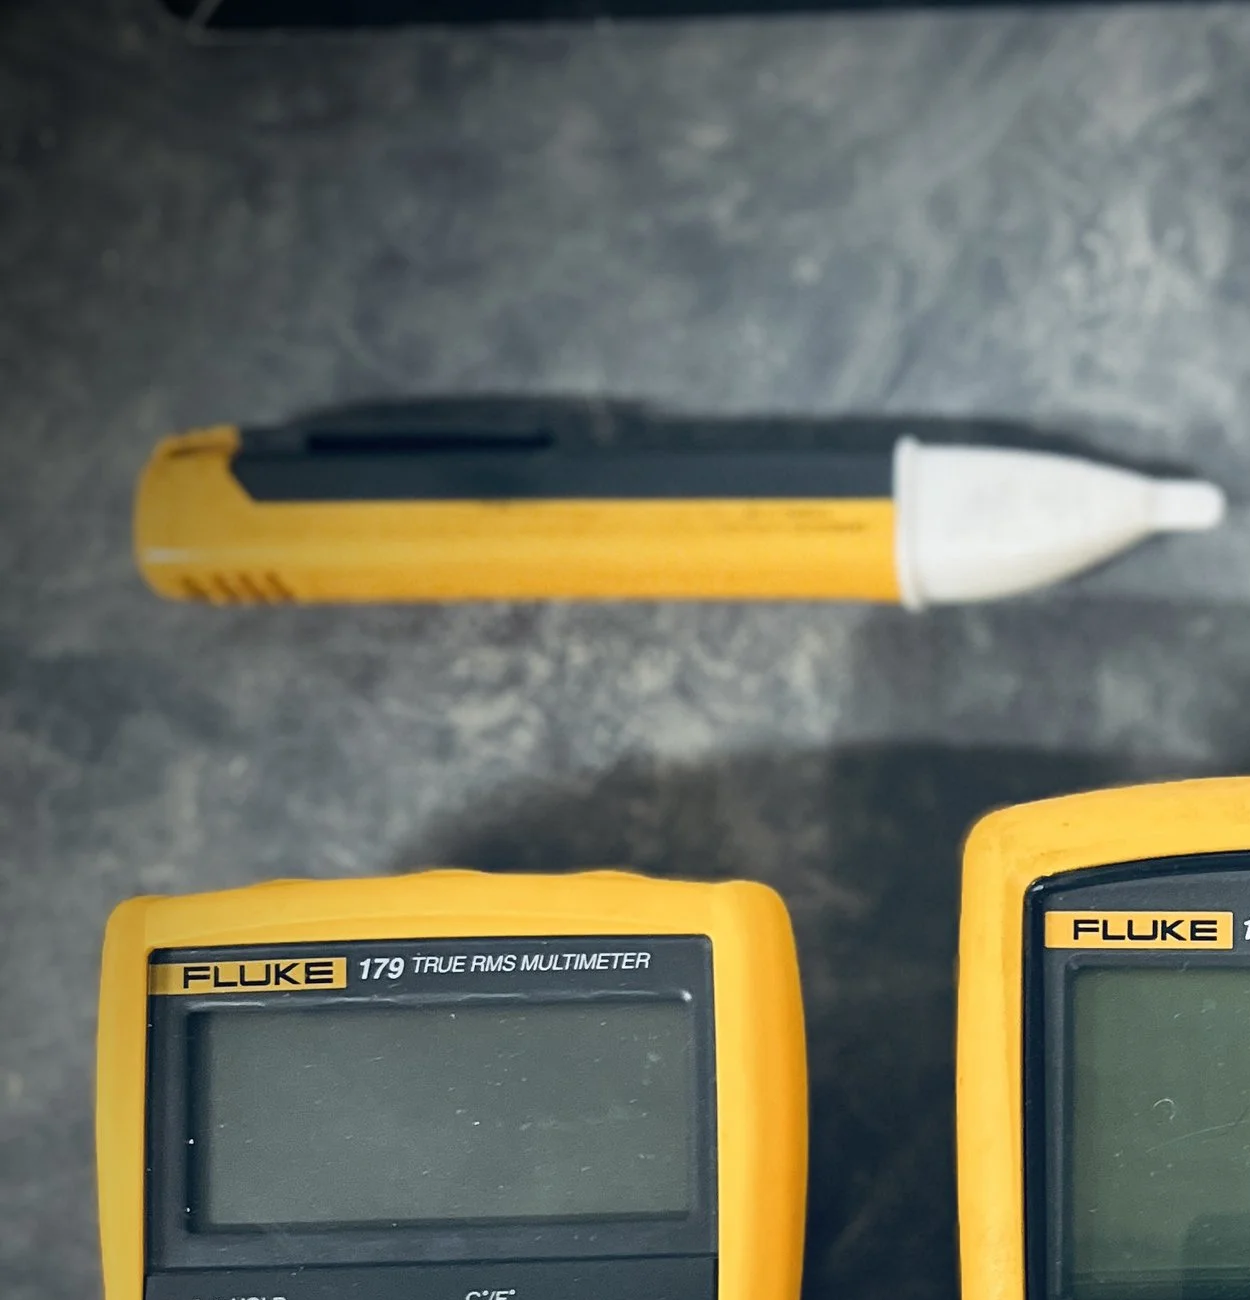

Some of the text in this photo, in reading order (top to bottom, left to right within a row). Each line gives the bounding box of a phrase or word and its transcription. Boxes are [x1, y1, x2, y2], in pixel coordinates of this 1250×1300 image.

[1073, 919, 1218, 941] FLUKE
[182, 951, 650, 989] FLUKE 179 TRUE RMS MULTIMETER
